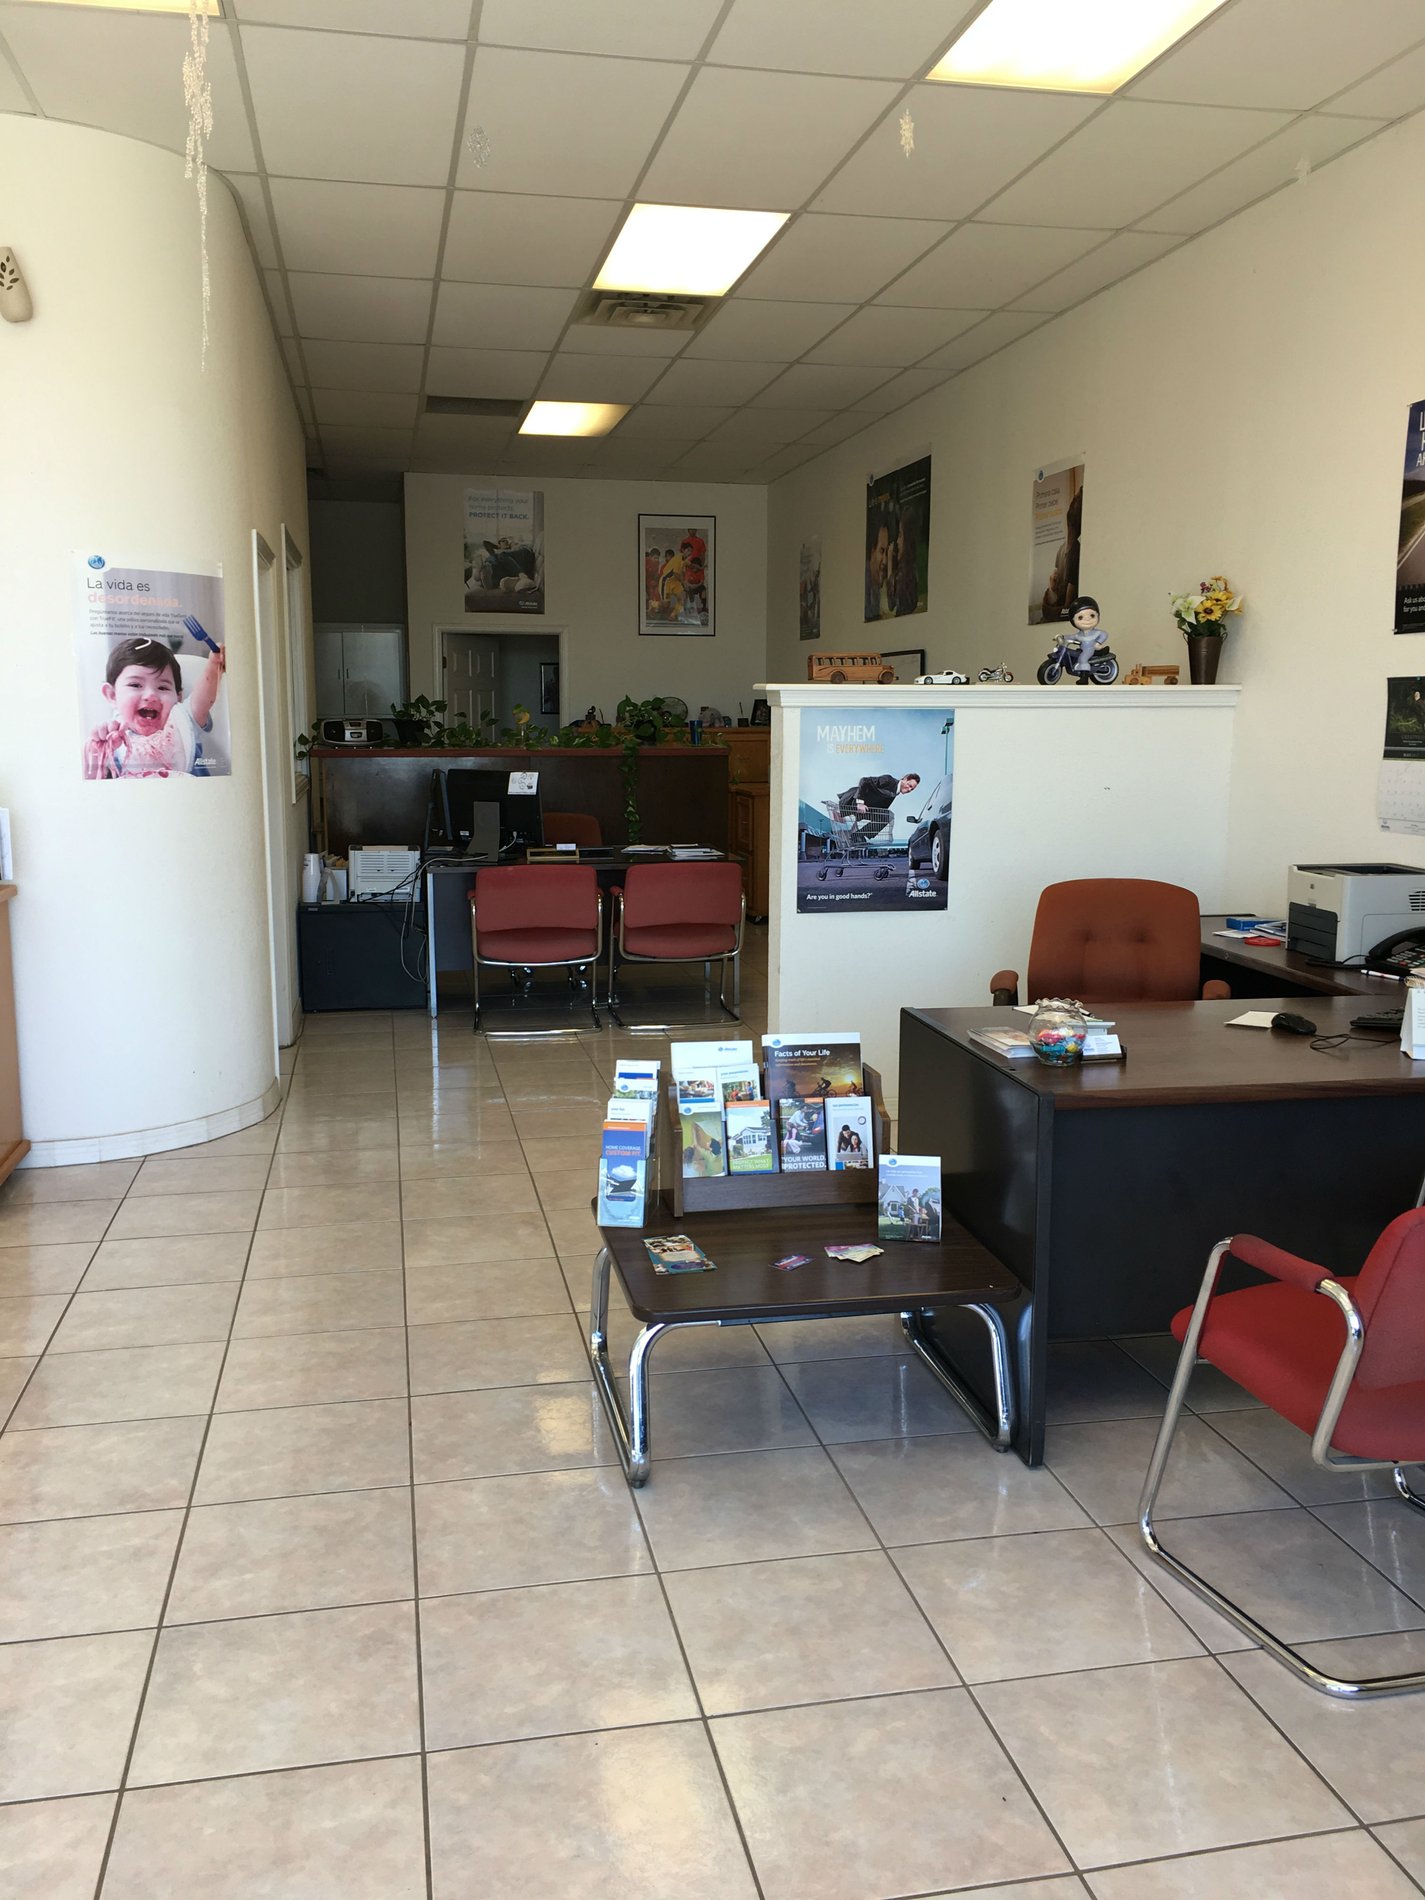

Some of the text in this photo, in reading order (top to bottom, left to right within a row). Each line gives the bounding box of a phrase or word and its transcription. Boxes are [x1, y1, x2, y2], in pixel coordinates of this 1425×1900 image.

[469, 511, 499, 519] PROTECT
[87, 577, 151, 592] La vida es
[817, 725, 876, 742] MAYHEM
[835, 743, 885, 753] EVERYWHERE
[835, 893, 850, 901] good
[908, 890, 937, 898] Allstate
[784, 1161, 827, 1169] PROTECTED.
